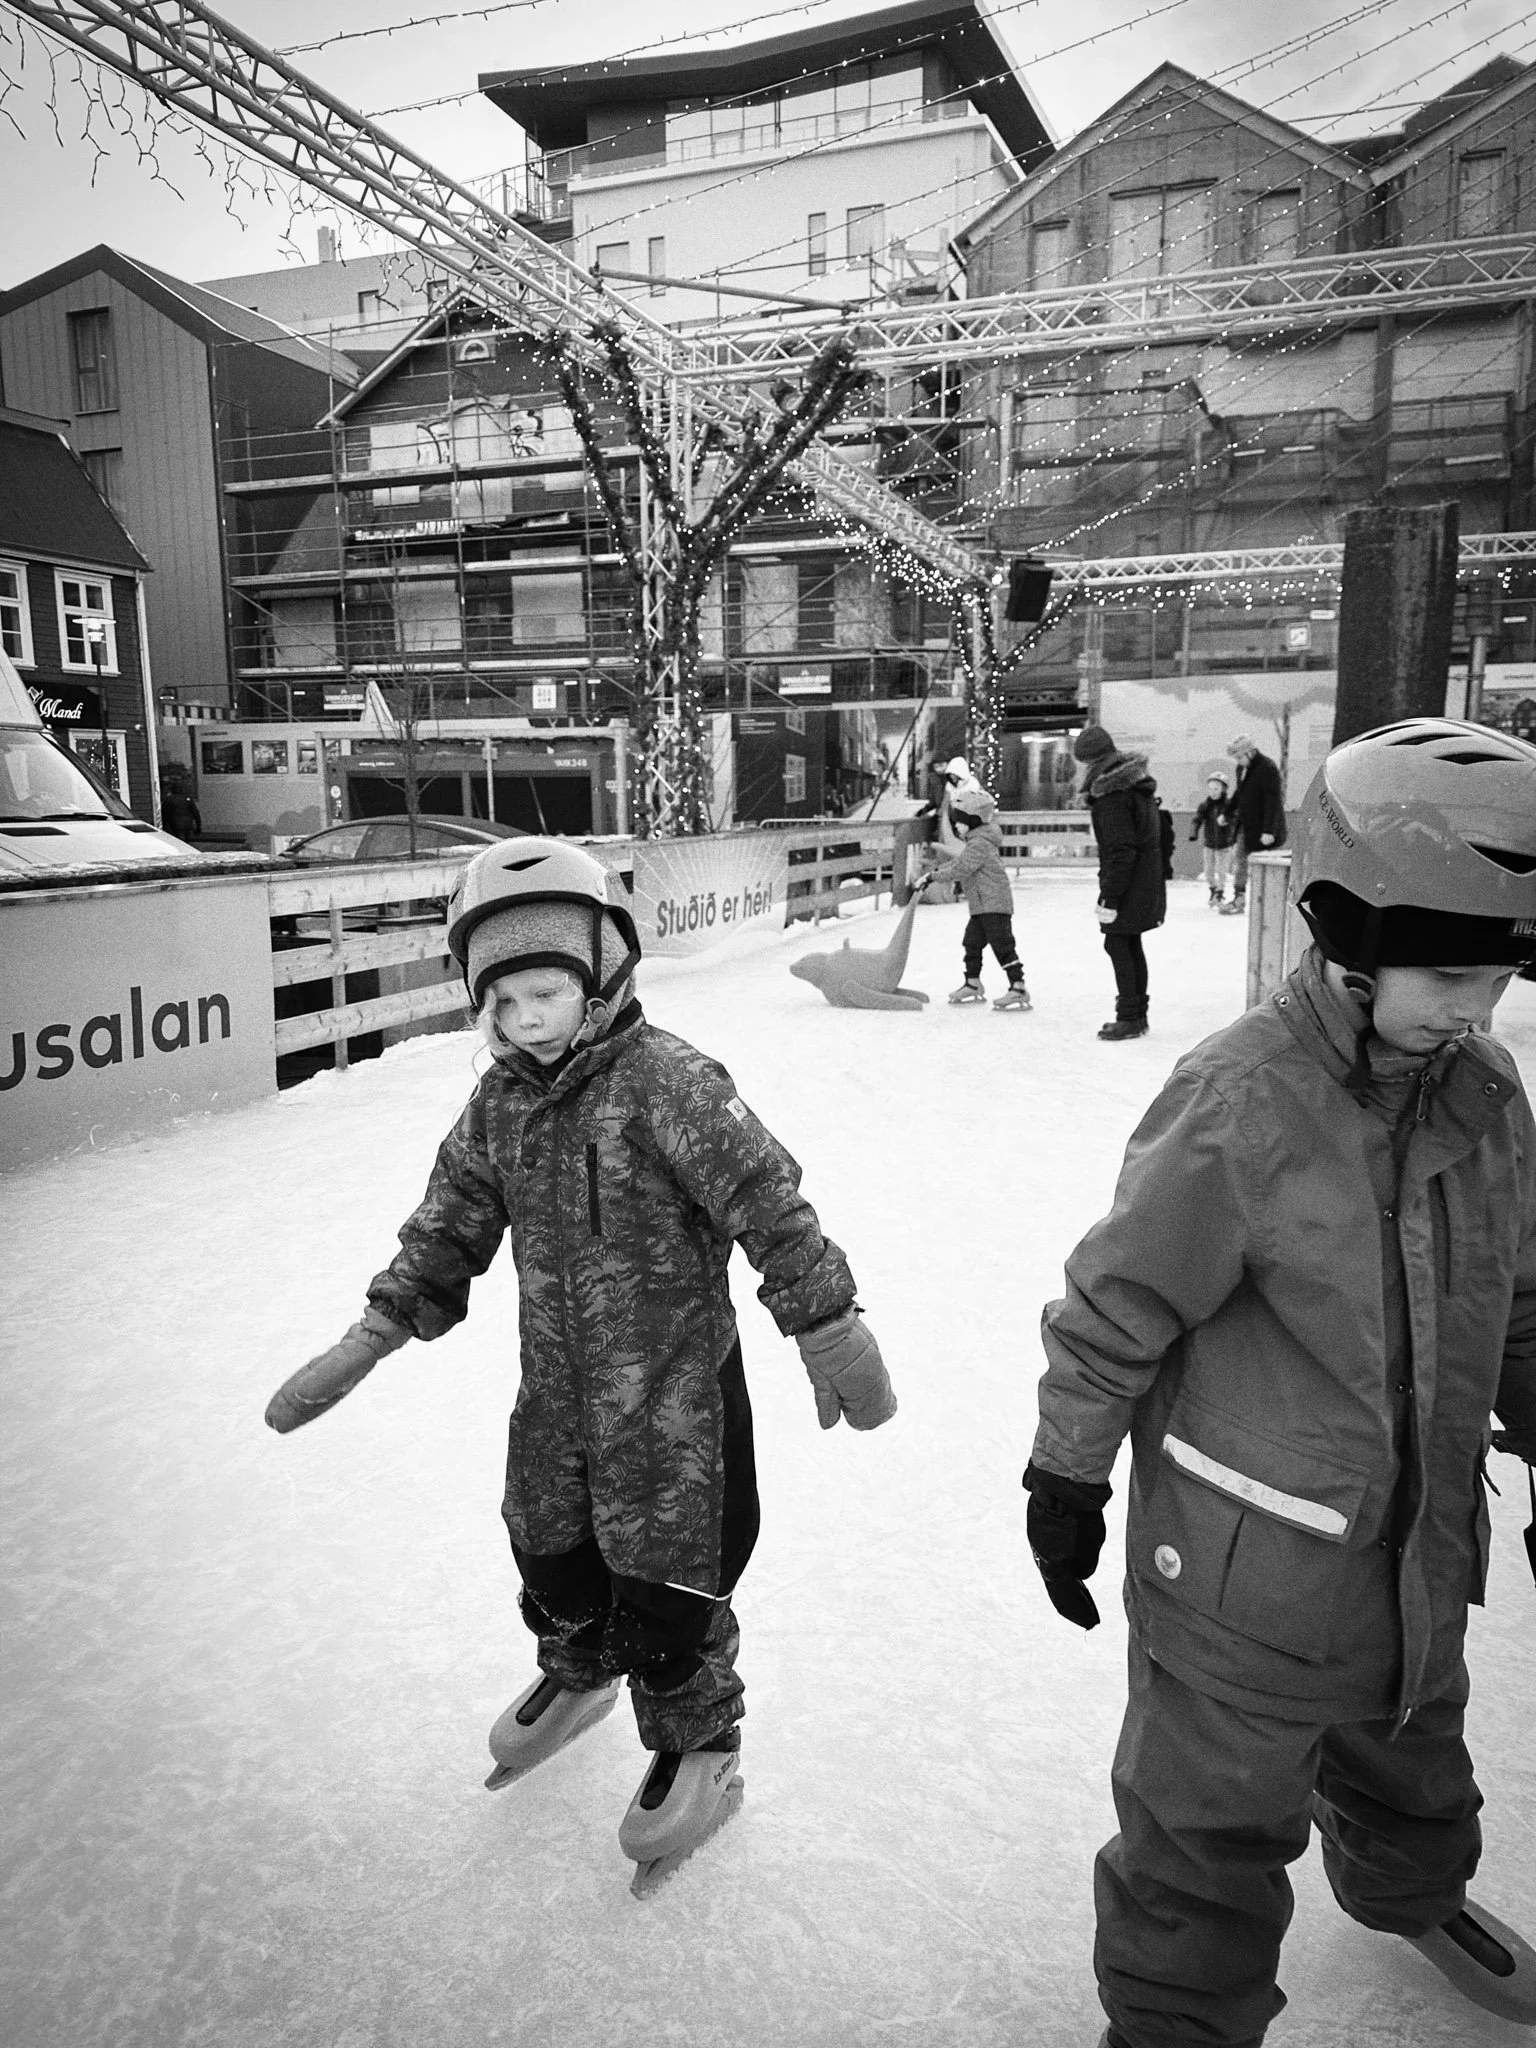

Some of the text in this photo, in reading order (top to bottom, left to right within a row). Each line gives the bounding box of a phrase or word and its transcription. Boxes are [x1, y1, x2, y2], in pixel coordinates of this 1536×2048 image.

[39, 698, 83, 719] Mandi
[657, 881, 773, 938] Stuðið er hér!
